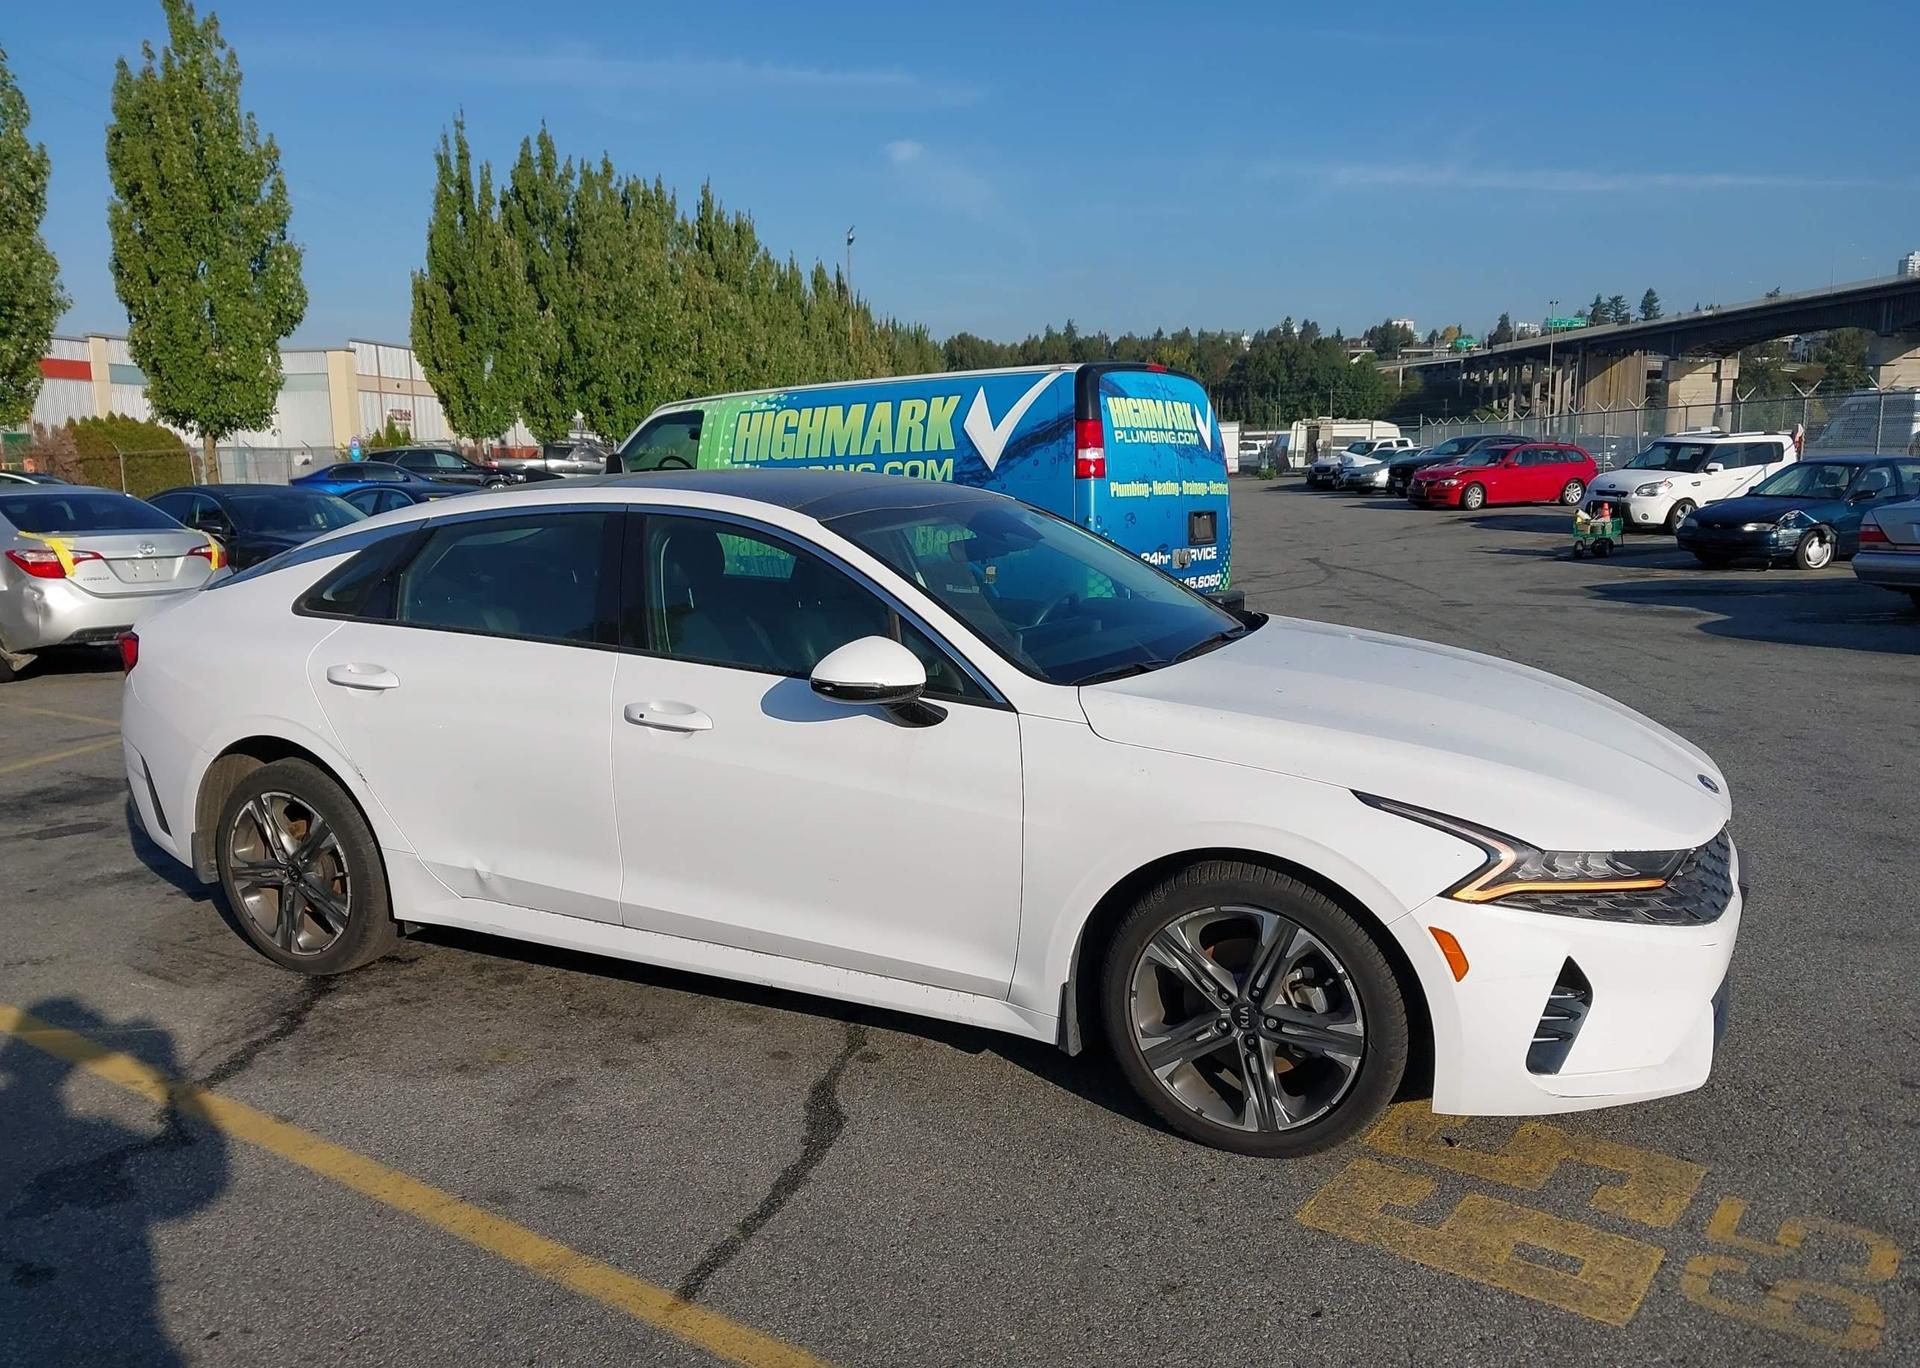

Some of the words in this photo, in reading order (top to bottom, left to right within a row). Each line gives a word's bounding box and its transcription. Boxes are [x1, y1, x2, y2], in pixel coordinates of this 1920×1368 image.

[1106, 397, 1197, 431] HIGHMARK
[732, 395, 961, 463] HIGHMARK
[1114, 430, 1200, 446] PLUMBING.COM
[1239, 1006, 1249, 1028] KIA
